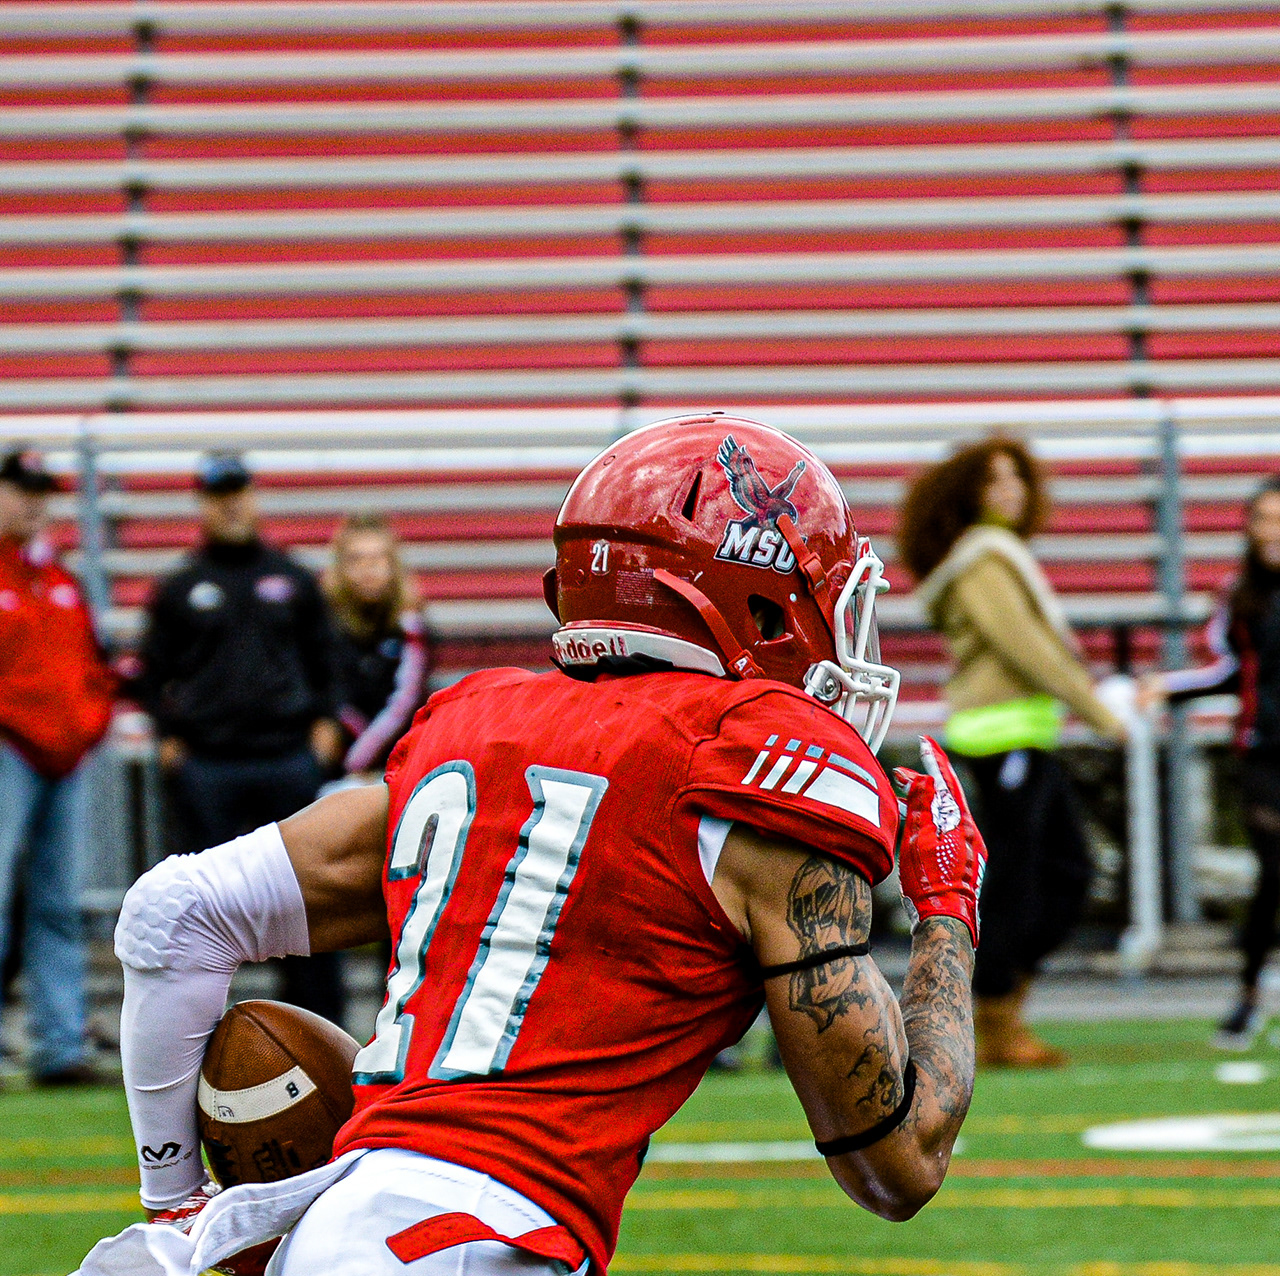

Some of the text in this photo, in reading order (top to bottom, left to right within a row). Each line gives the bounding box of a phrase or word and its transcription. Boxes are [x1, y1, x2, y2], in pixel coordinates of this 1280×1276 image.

[591, 543, 610, 572] 21
[718, 522, 797, 571] MSU
[352, 759, 609, 1085] 21
